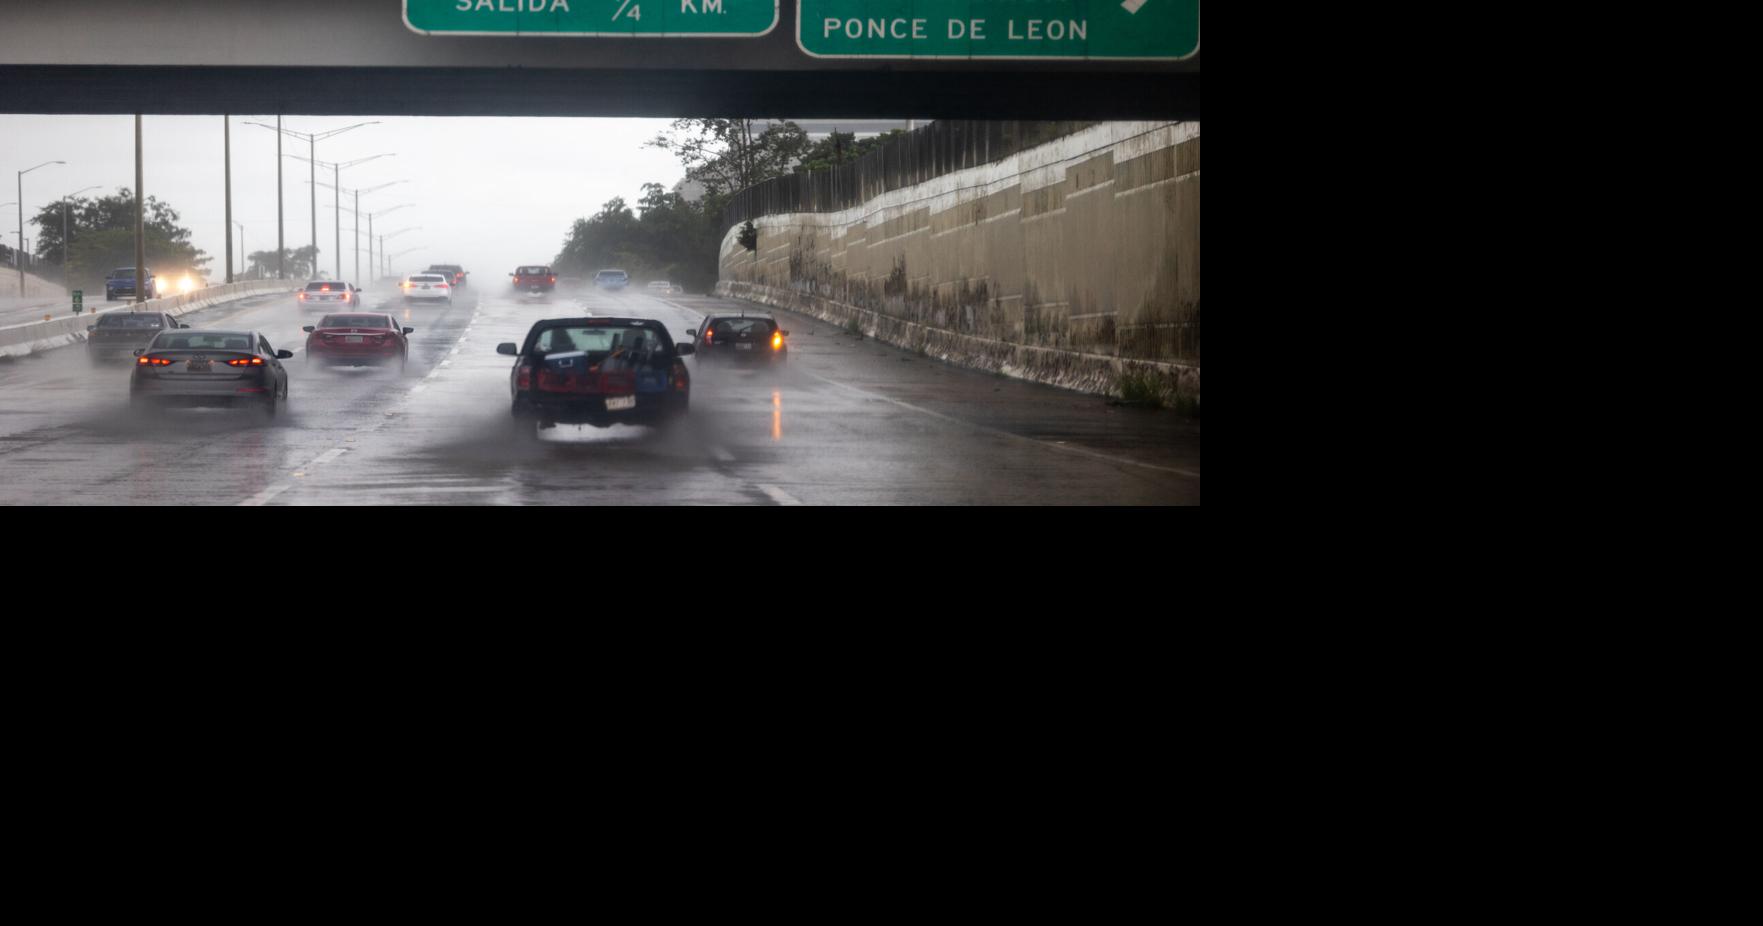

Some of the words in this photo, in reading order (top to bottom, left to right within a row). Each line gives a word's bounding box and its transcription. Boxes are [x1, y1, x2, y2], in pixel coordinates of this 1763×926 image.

[823, 18, 927, 39] PONCE
[948, 19, 985, 39] DE
[1008, 20, 1087, 39] LEON
